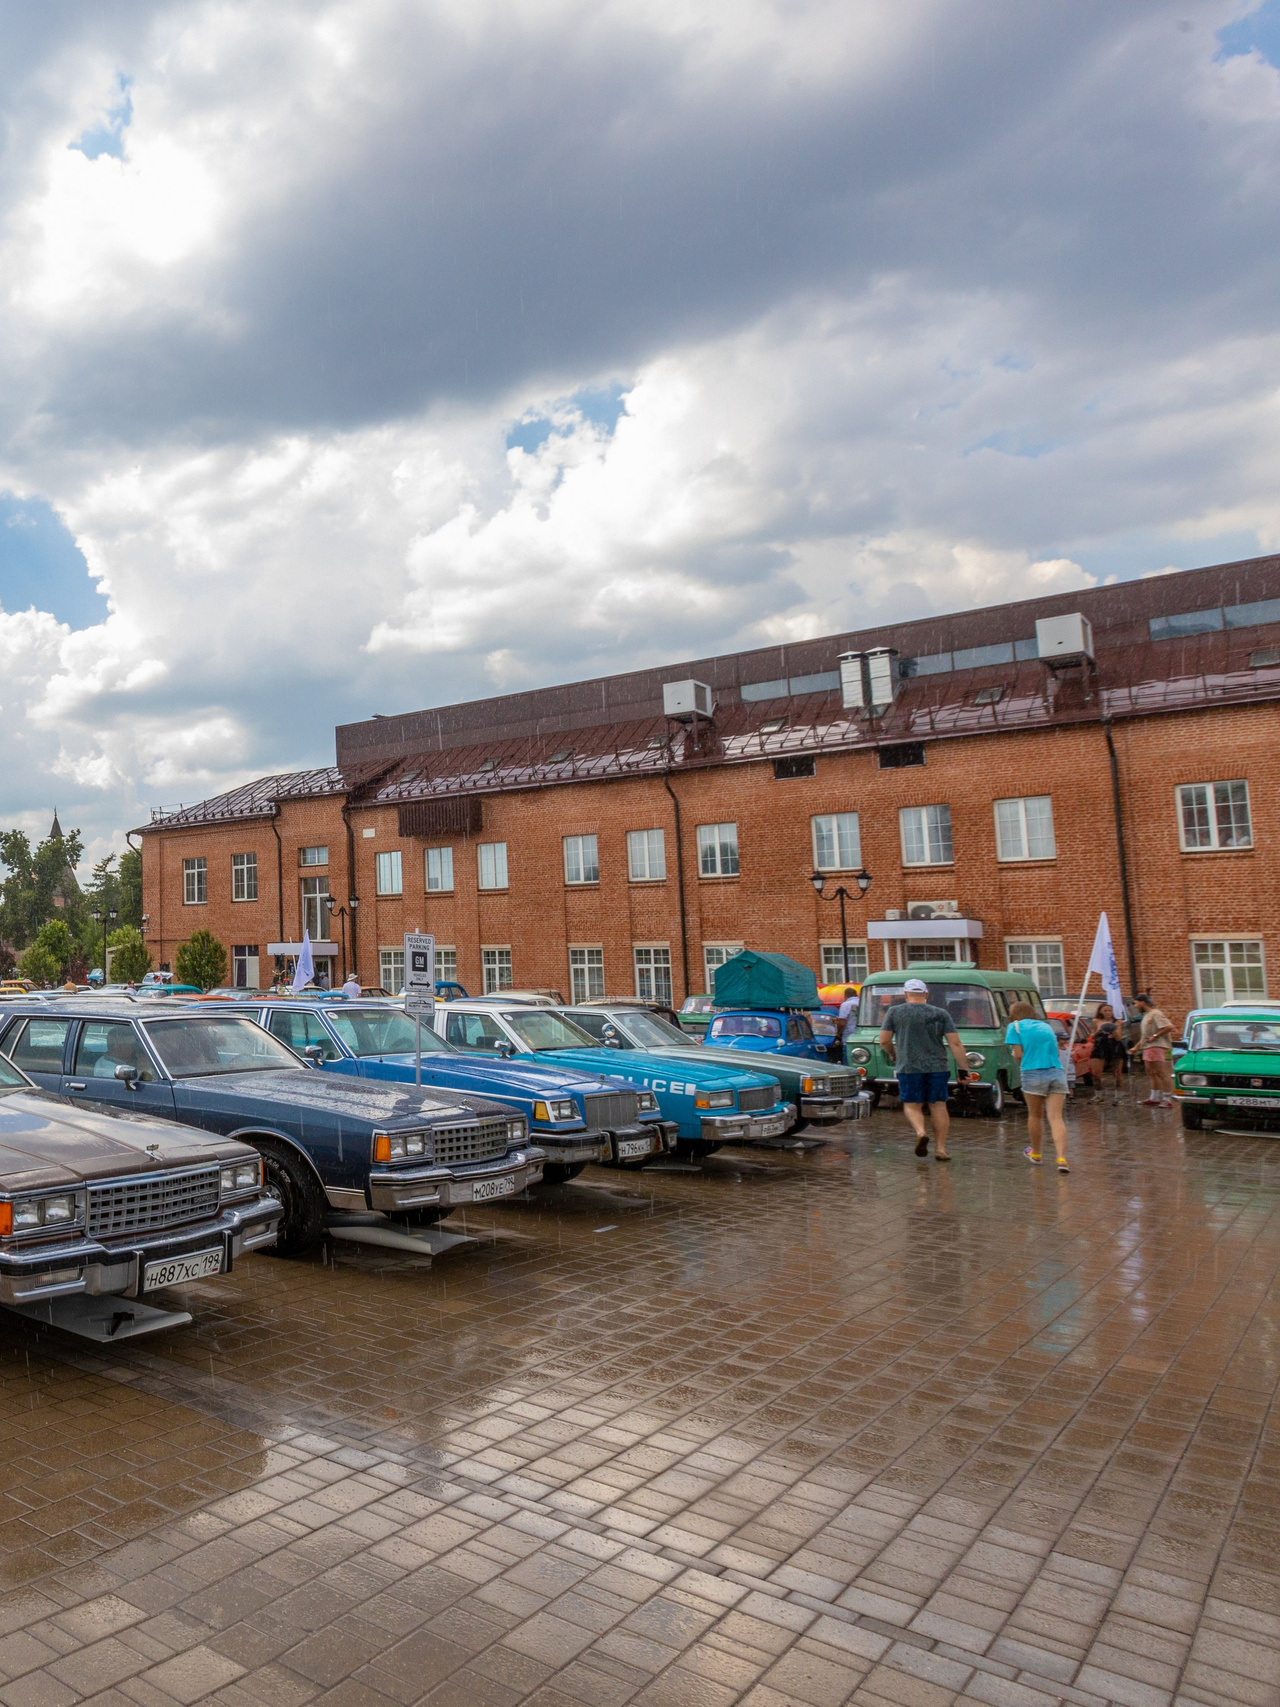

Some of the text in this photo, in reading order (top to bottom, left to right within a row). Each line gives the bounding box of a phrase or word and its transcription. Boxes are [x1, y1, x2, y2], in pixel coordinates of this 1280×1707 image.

[407, 936, 432, 945] RESERVED
[409, 943, 430, 951] PARKING
[414, 955, 425, 965] GM
[202, 1253, 220, 1269] 199
